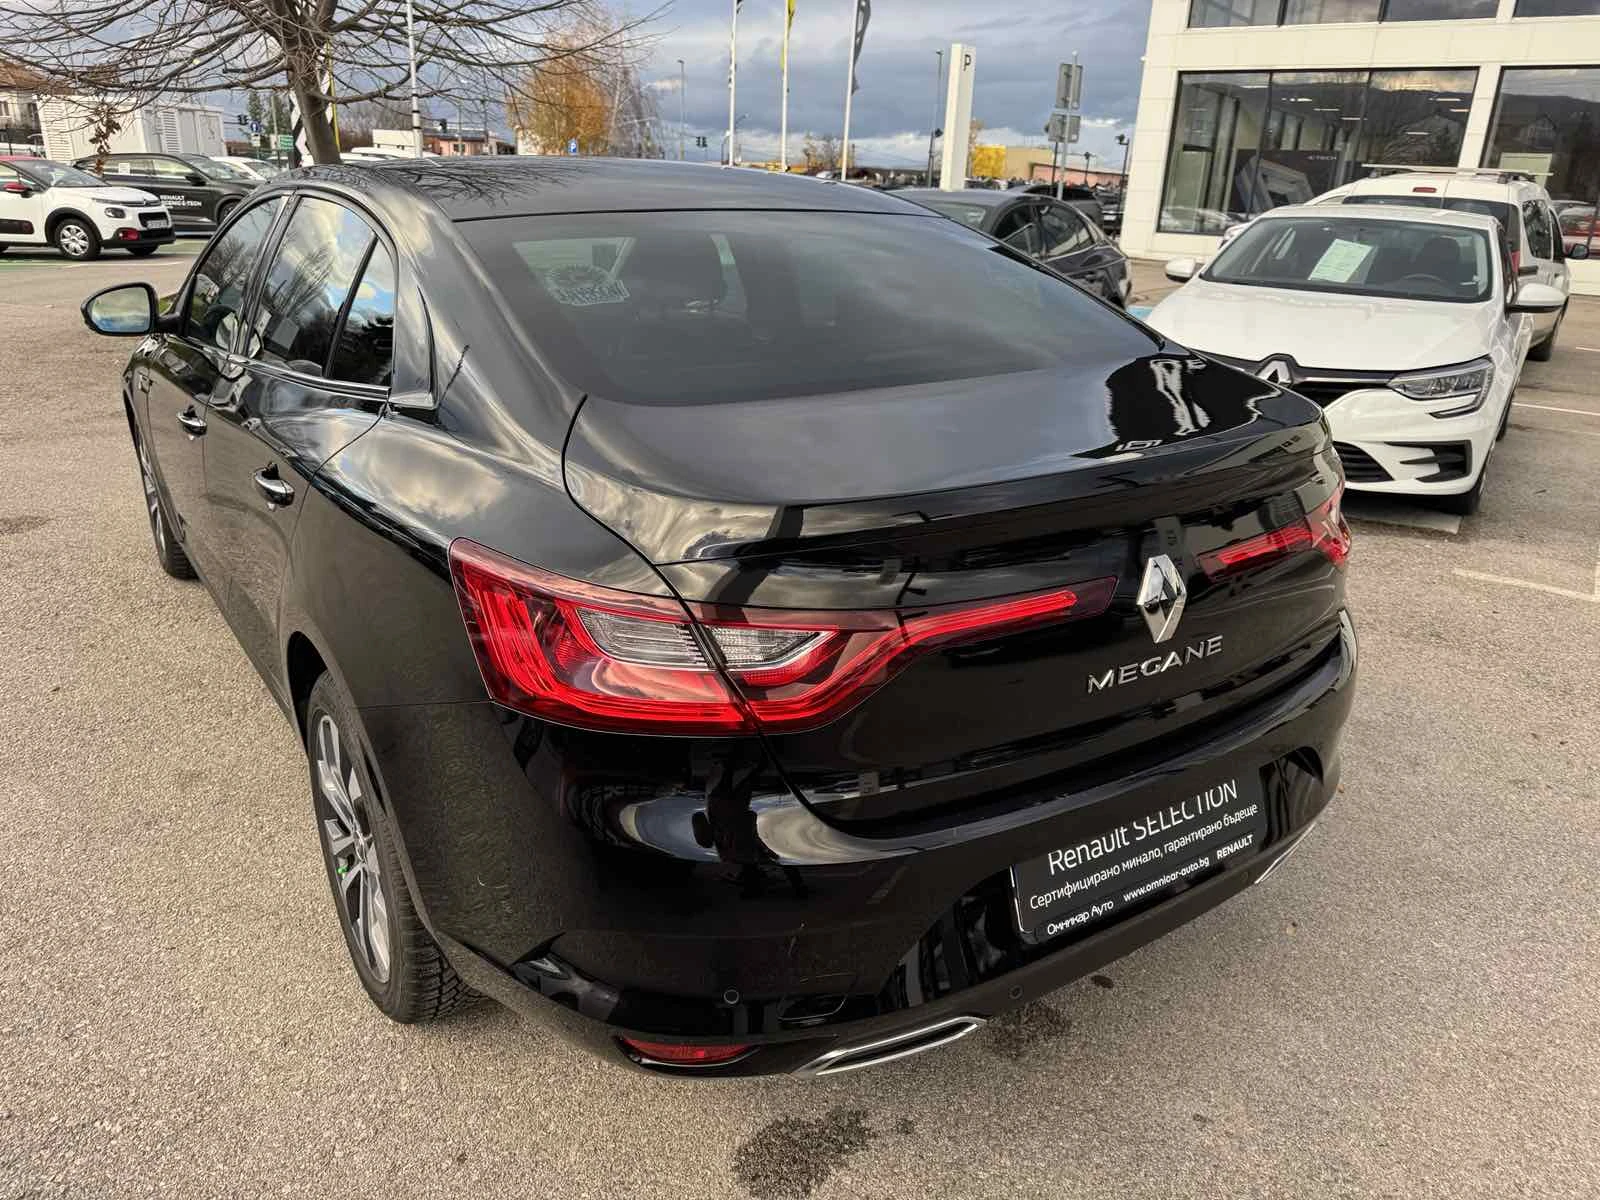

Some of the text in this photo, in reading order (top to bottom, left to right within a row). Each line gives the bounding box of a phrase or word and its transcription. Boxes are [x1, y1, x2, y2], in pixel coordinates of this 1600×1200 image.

[1087, 634, 1224, 694] MEGANE
[1030, 802, 1258, 910] Сертифицирано минало, гарантирано бъдеще
[1047, 778, 1238, 876] Renault SELECTION
[1047, 834, 1254, 936] Омникар Ауто www.omnicar-auto.bg RENAULT
